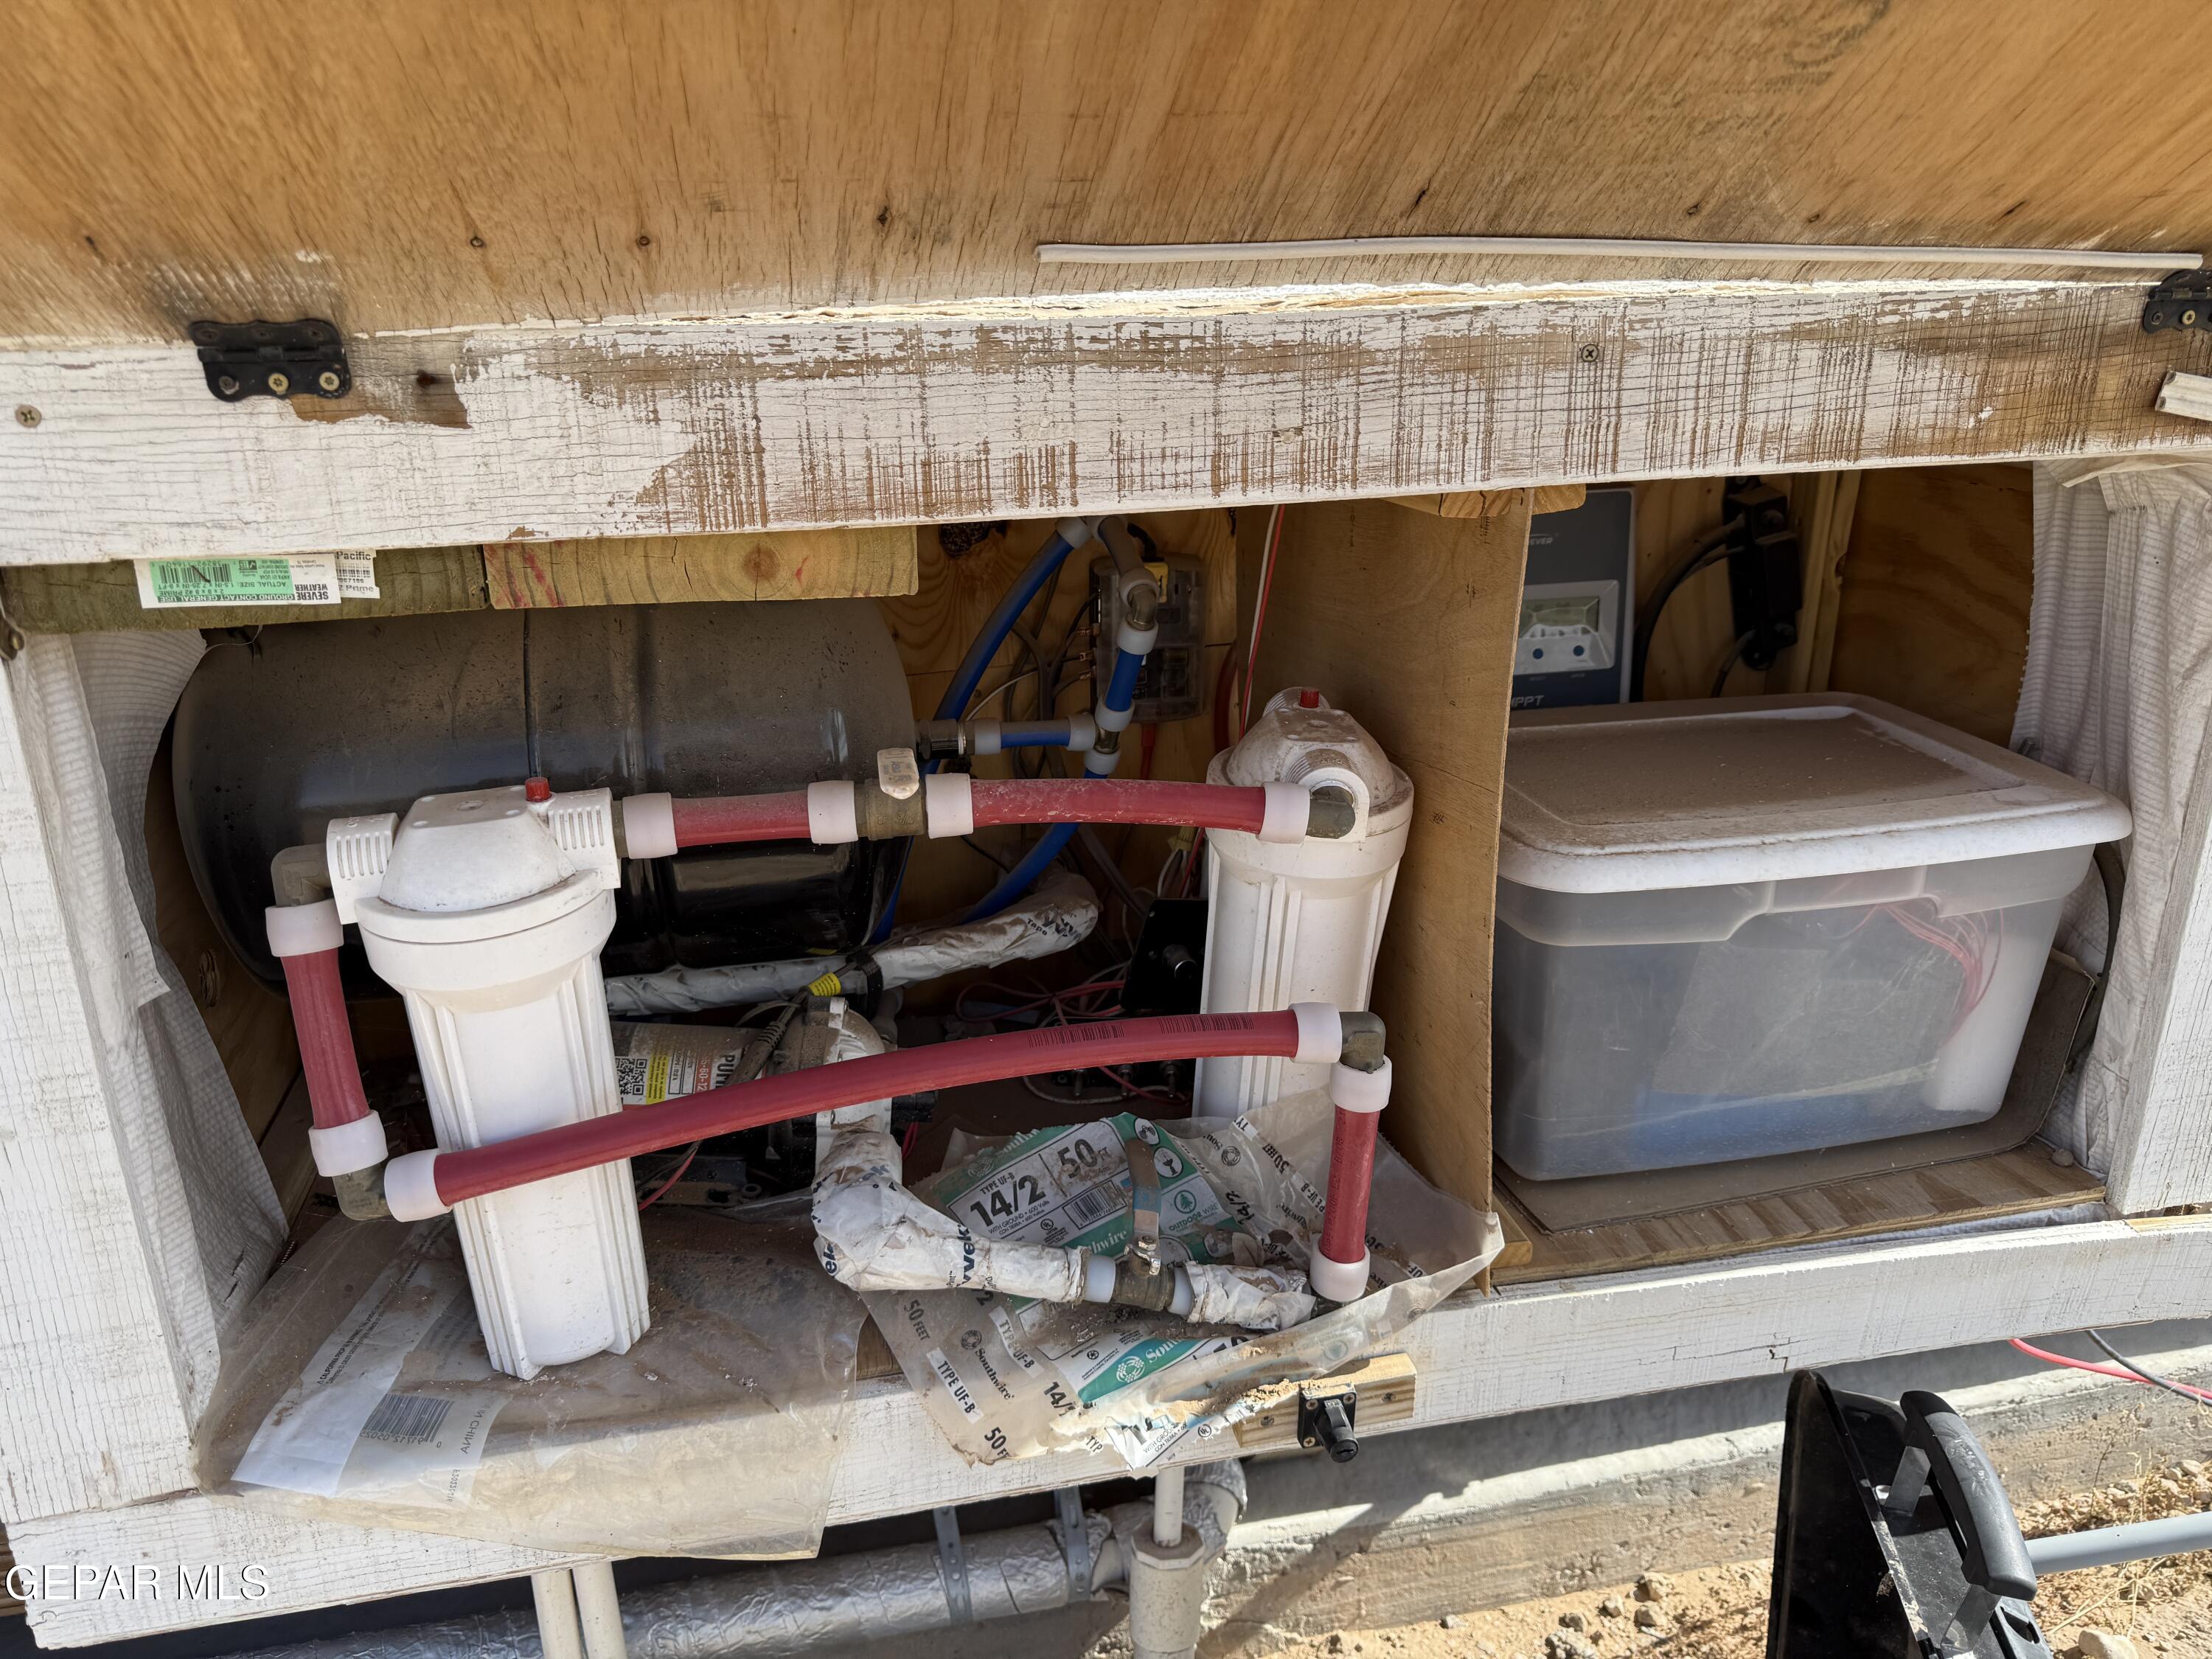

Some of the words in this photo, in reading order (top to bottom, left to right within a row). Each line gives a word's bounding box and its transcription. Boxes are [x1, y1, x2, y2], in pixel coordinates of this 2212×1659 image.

[336, 551, 372, 560] Pacific
[295, 583, 328, 591] WEATHER
[296, 591, 329, 601] SEVERE
[1027, 918, 1048, 936] Tape
[714, 1054, 736, 1088] PUM
[1234, 1117, 1249, 1131] TY
[1057, 1139, 1098, 1179] 50
[980, 1182, 999, 1194] TYPE
[997, 1172, 1015, 1186] UF-B
[1301, 1183, 1316, 1203] UF-B
[970, 1175, 1047, 1227] 14/2
[988, 1223, 1003, 1235] WITH
[1001, 1214, 1025, 1229] GROUND
[1169, 1211, 1203, 1231] OUTDOOR
[1202, 1202, 1220, 1216] WIRE
[998, 1228, 1009, 1236] CON
[1407, 1265, 1424, 1278] UF-
[904, 1299, 925, 1322] 50
[913, 1320, 931, 1341] FEET
[1012, 1350, 1036, 1369] UF-B
[975, 1347, 1014, 1400] Southwire
[938, 1360, 959, 1388] TYPE
[953, 1385, 975, 1414] UF-B
[984, 1427, 1007, 1450] 50
[1085, 1435, 1104, 1455] TYP
[1144, 1441, 1157, 1453] WITH
[1155, 1427, 1177, 1446] GROU
[1154, 1443, 1166, 1453] CON
[1164, 1432, 1178, 1446] TIERRA
